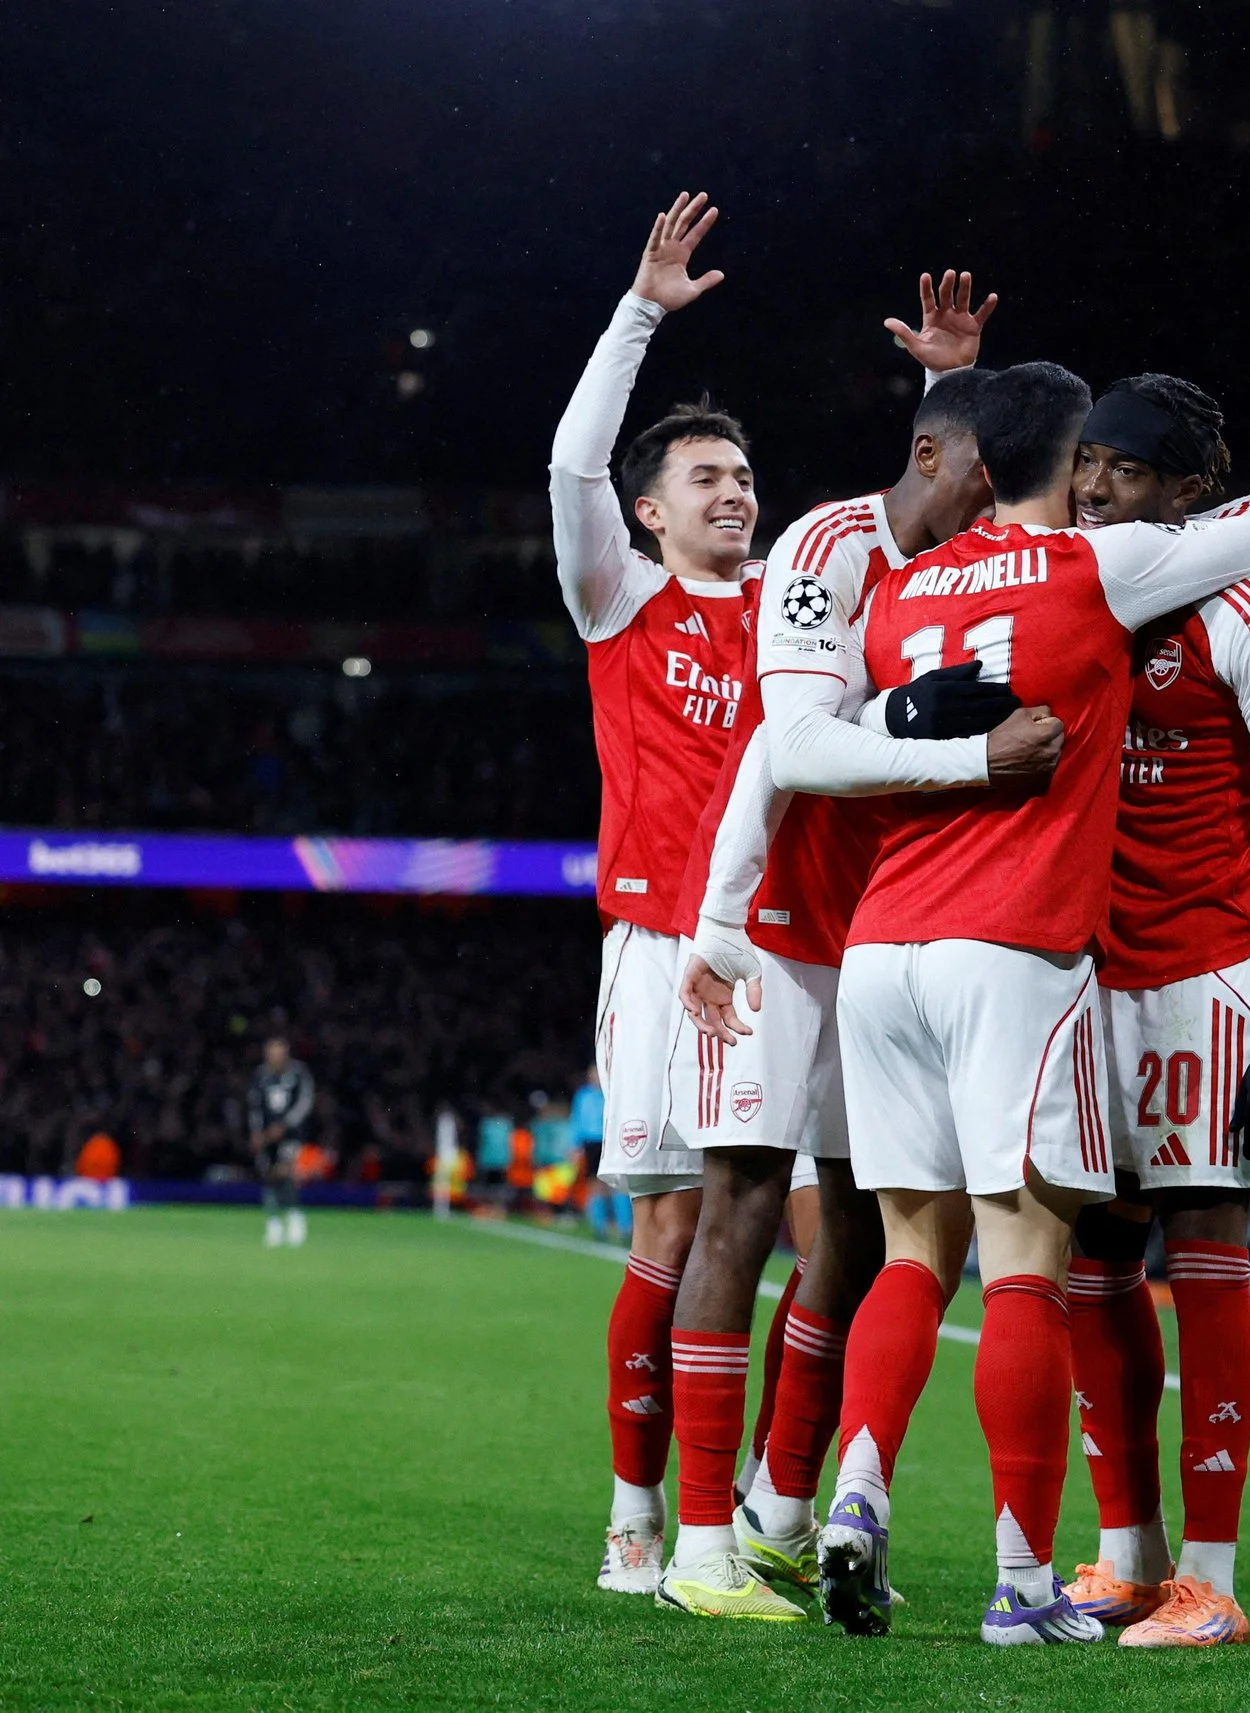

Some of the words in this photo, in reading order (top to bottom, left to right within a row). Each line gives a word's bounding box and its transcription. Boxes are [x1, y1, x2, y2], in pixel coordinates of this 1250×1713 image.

[898, 546, 1048, 600] MARTINELLI
[901, 616, 1015, 684] 11
[682, 694, 718, 726] FLY
[1136, 1050, 1203, 1127] 20
